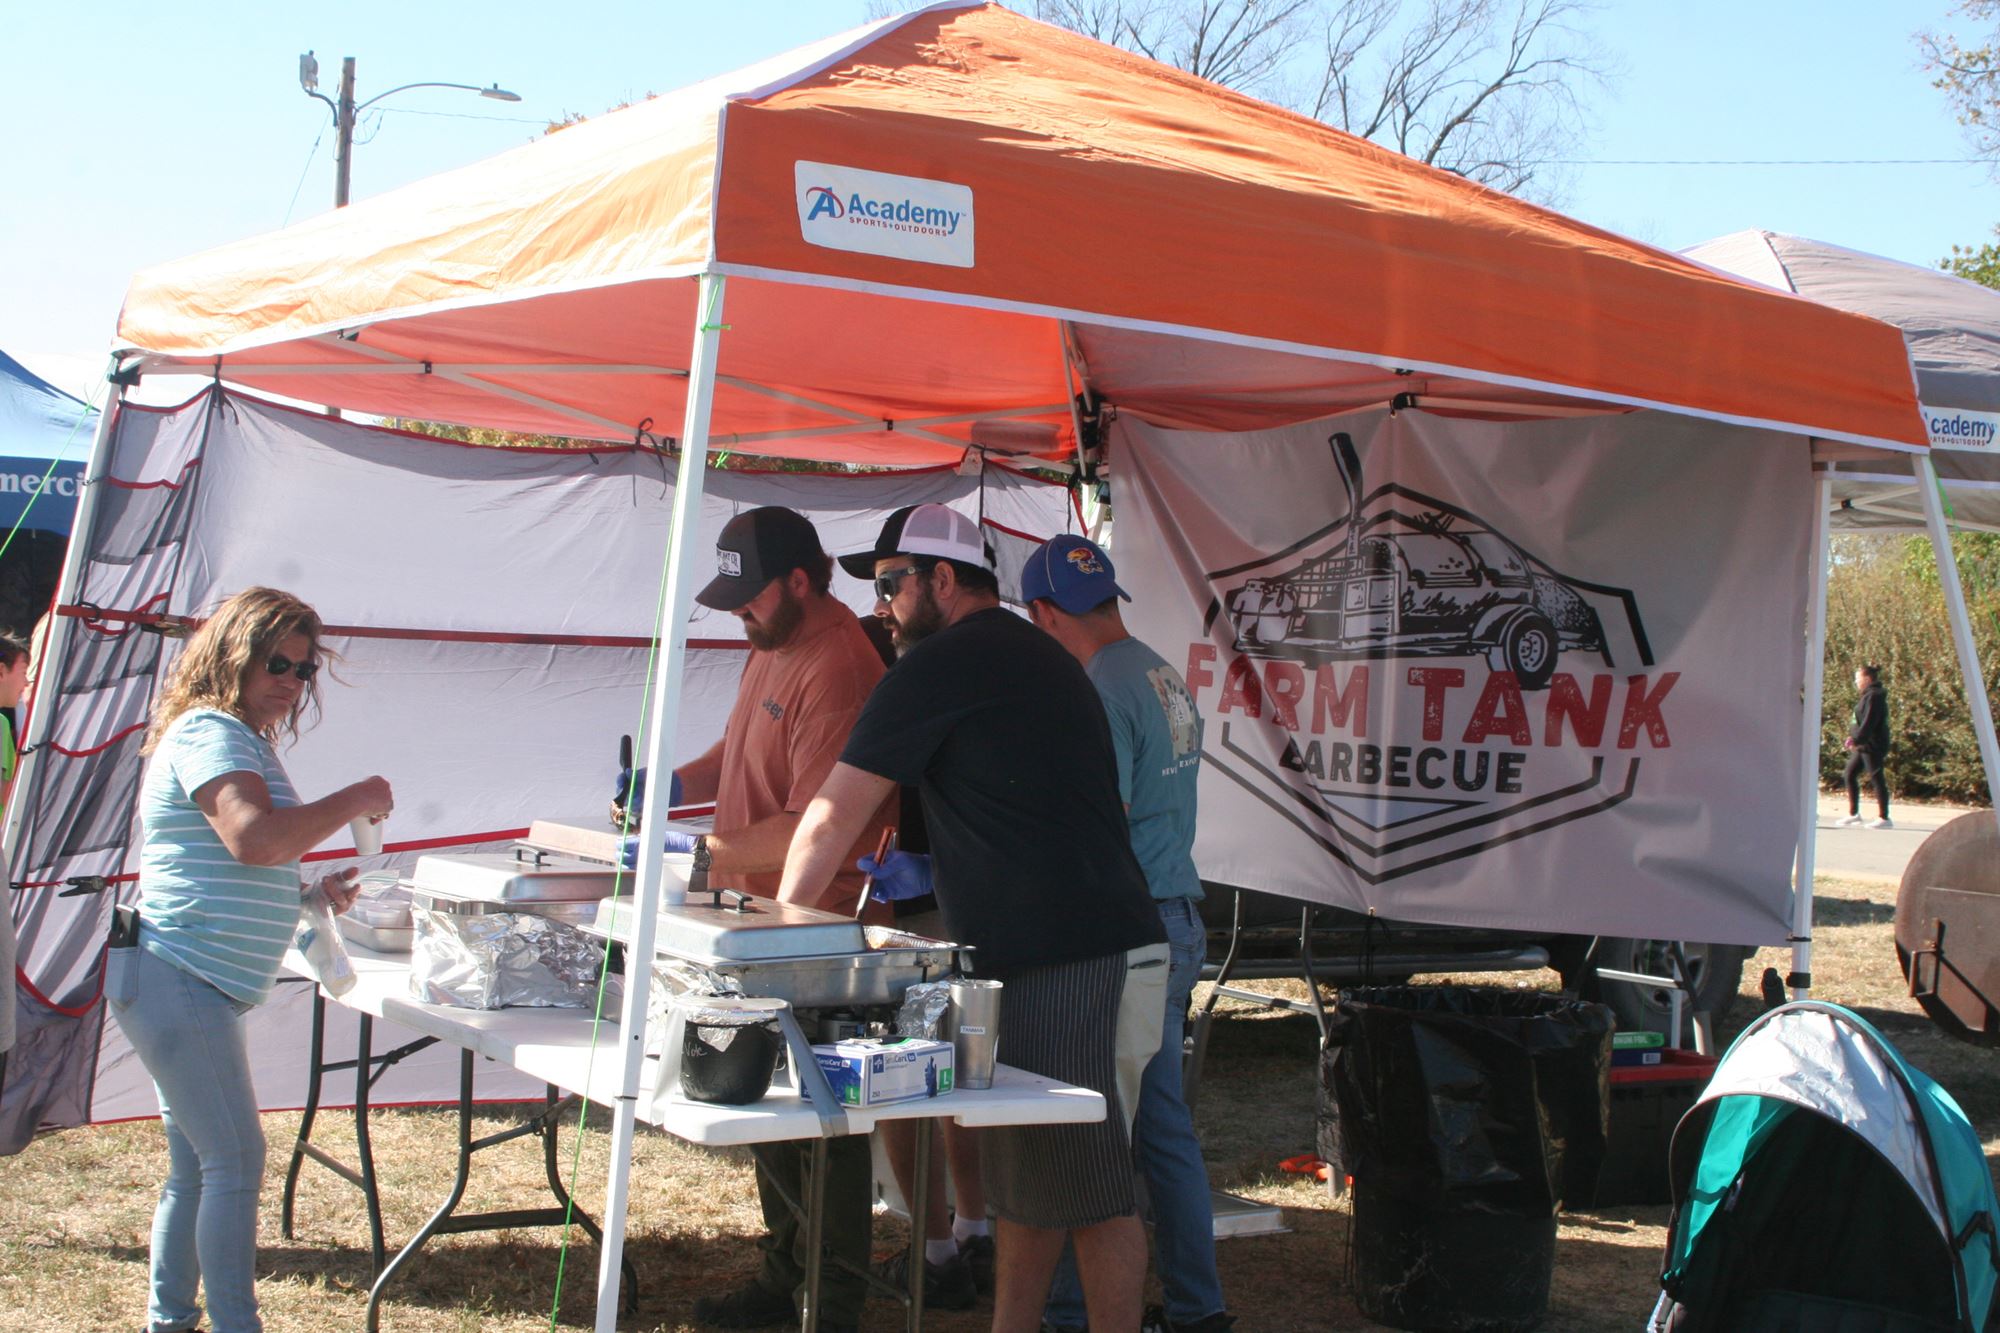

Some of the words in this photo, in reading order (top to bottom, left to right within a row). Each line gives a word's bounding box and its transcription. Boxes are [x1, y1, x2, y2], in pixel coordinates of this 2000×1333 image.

[848, 193, 960, 235] Academy
[1924, 411, 1995, 444] cademy
[1185, 642, 1369, 738] FARM
[1406, 667, 1682, 749] TANK
[850, 1087, 856, 1099] L
[944, 1071, 949, 1085] L
